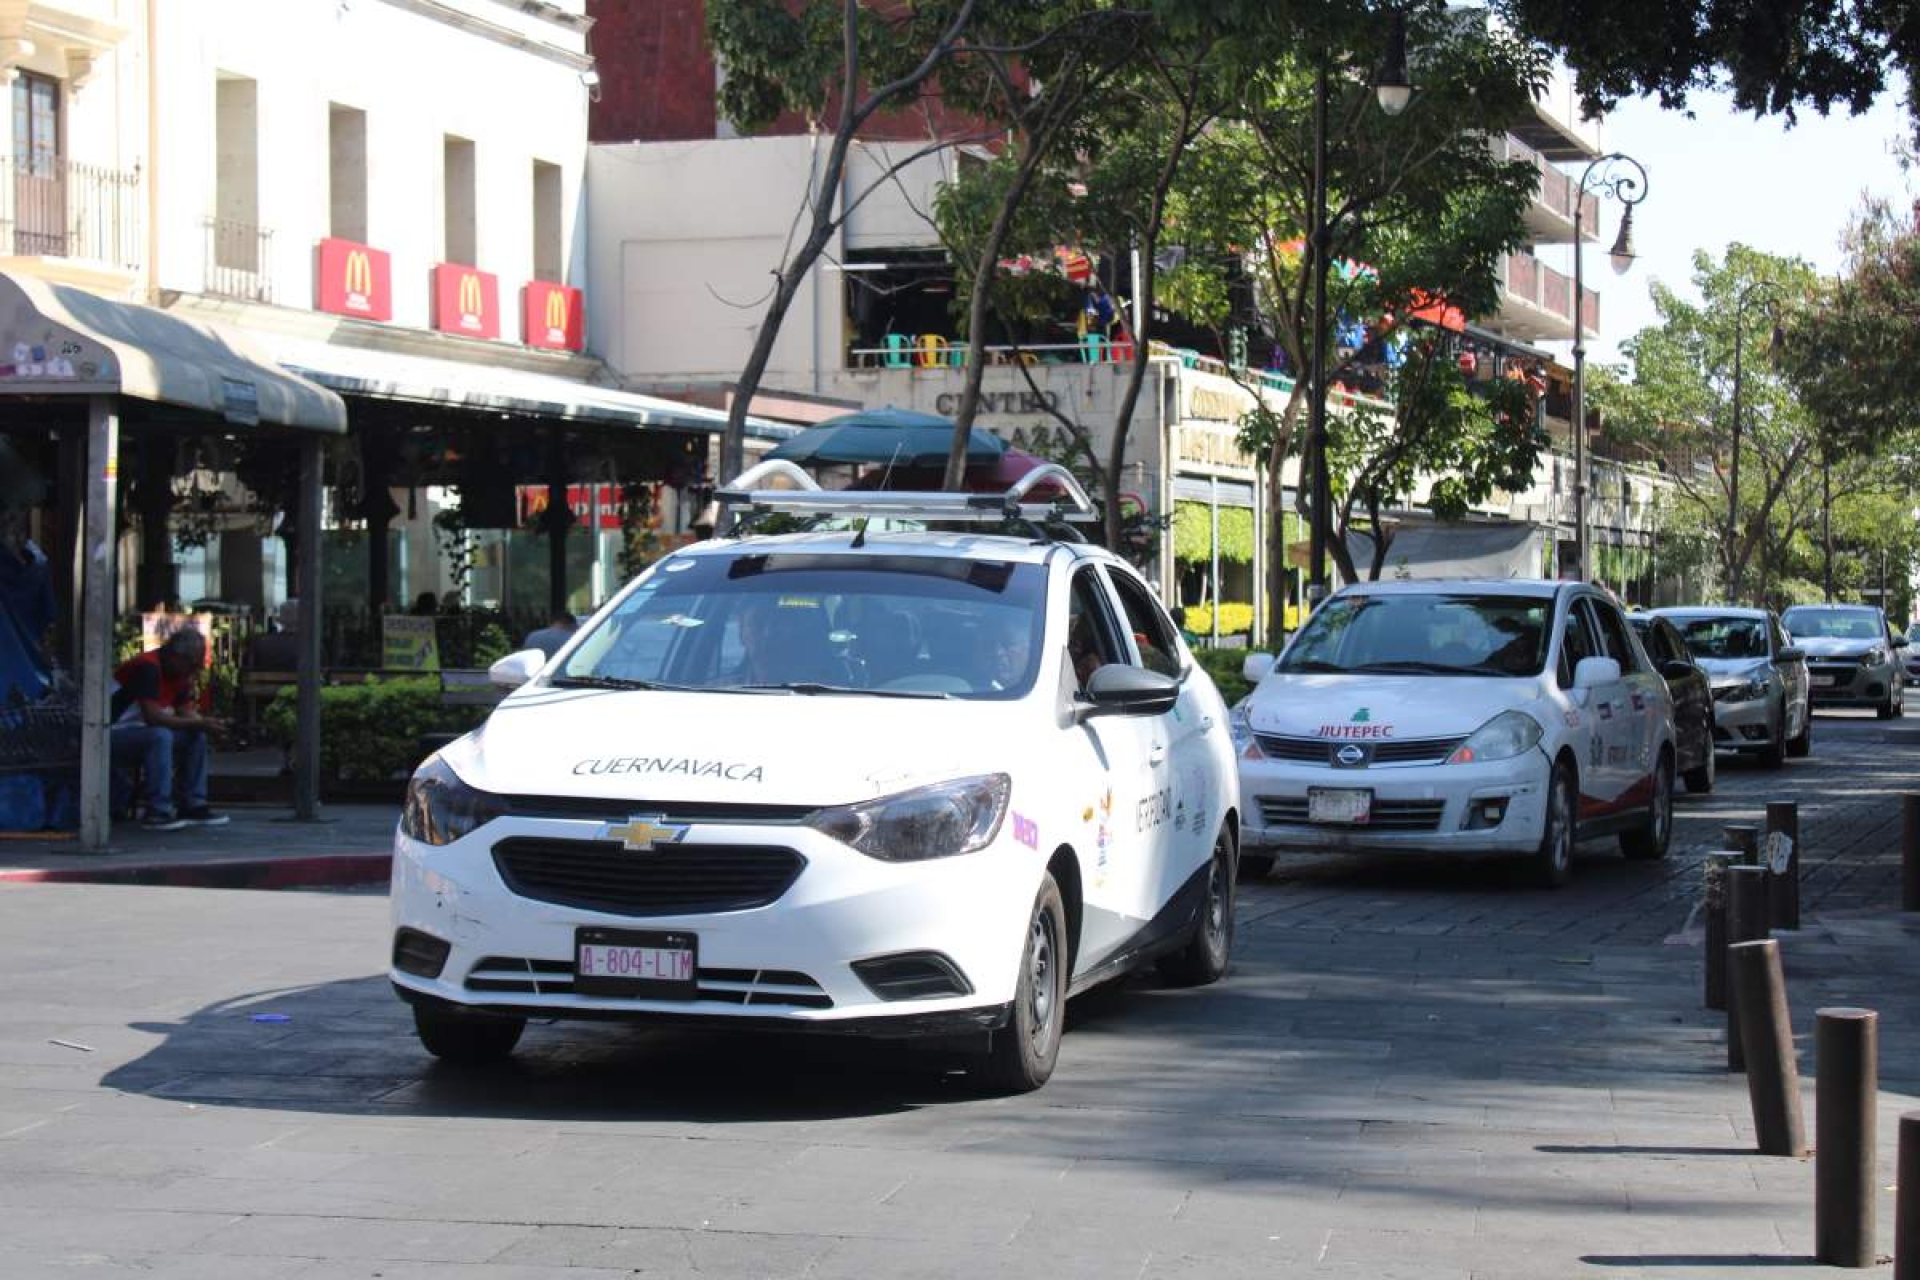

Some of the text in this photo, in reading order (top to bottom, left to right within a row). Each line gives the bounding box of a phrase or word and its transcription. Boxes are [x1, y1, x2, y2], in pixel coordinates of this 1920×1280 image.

[1316, 724, 1395, 739] JIUTEPEC
[572, 757, 764, 784] CUERNAVACA
[581, 946, 692, 979] A-804-LTM
